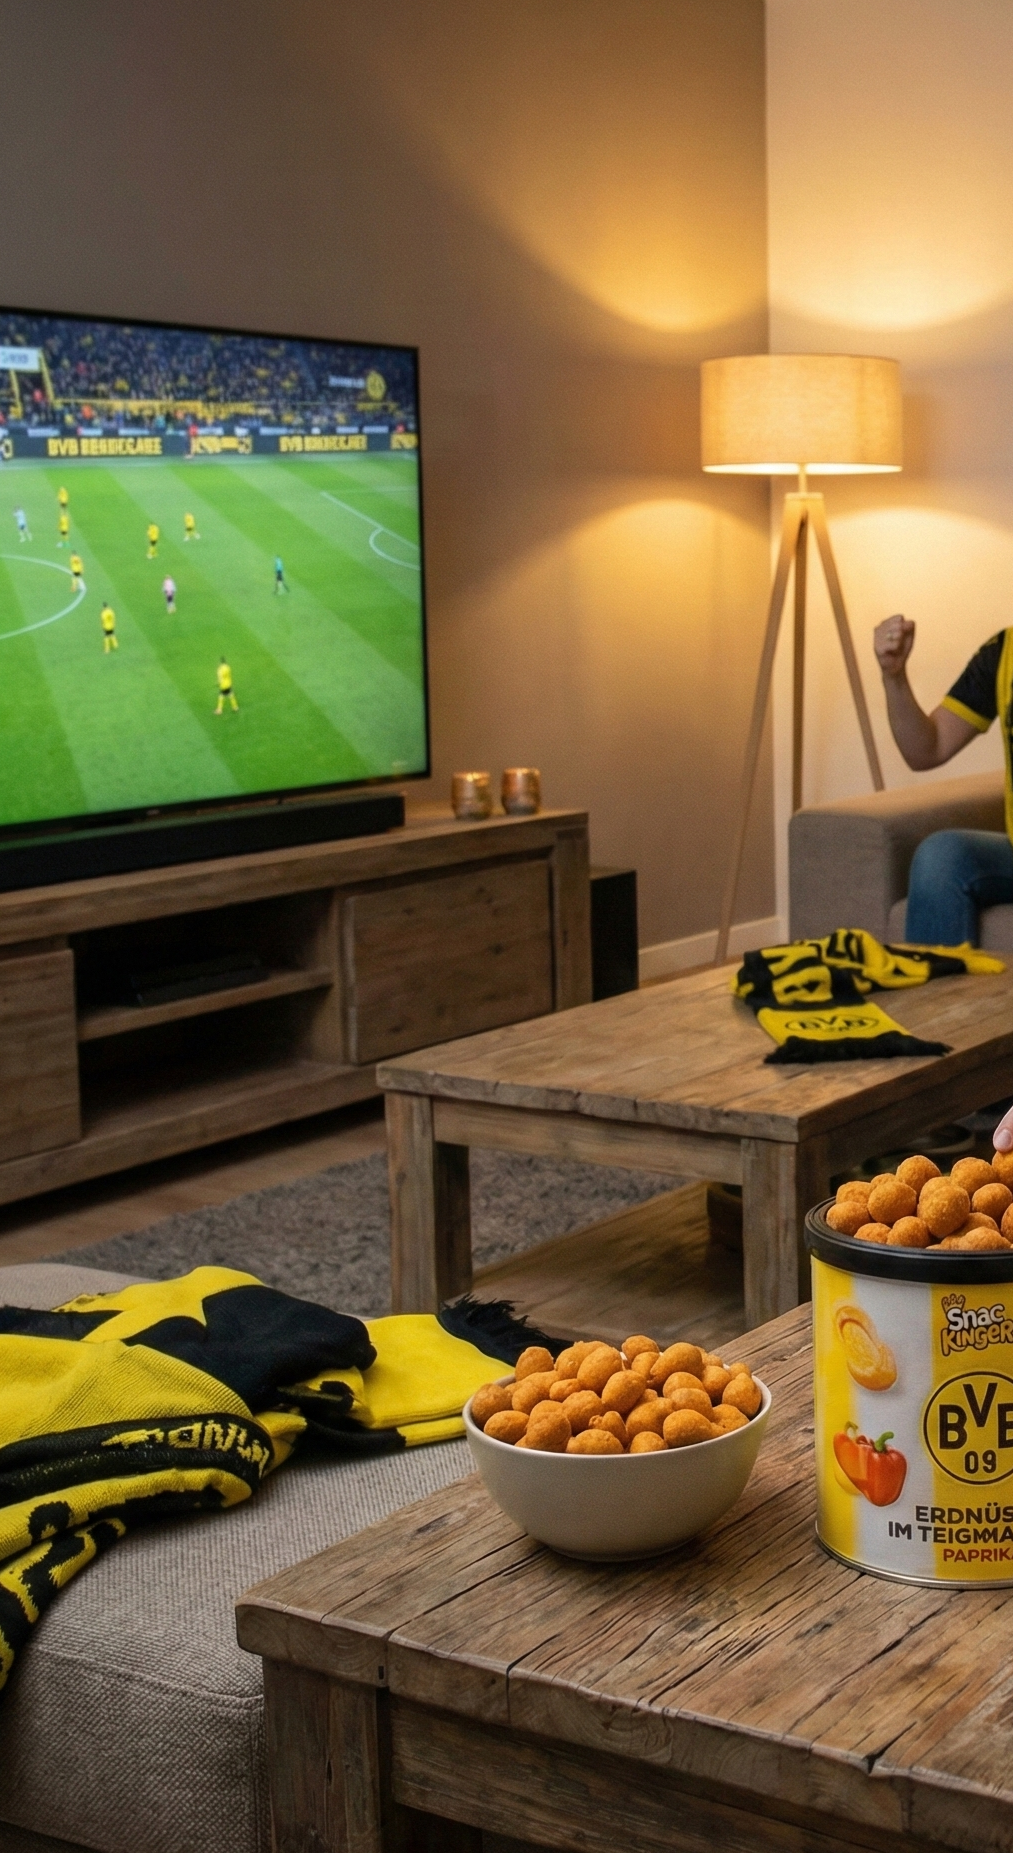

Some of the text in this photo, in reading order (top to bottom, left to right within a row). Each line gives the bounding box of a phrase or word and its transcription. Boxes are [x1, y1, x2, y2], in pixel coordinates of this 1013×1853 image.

[946, 1303, 1005, 1332] Snac
[964, 1450, 997, 1474] 09
[888, 1521, 912, 1540] IM
